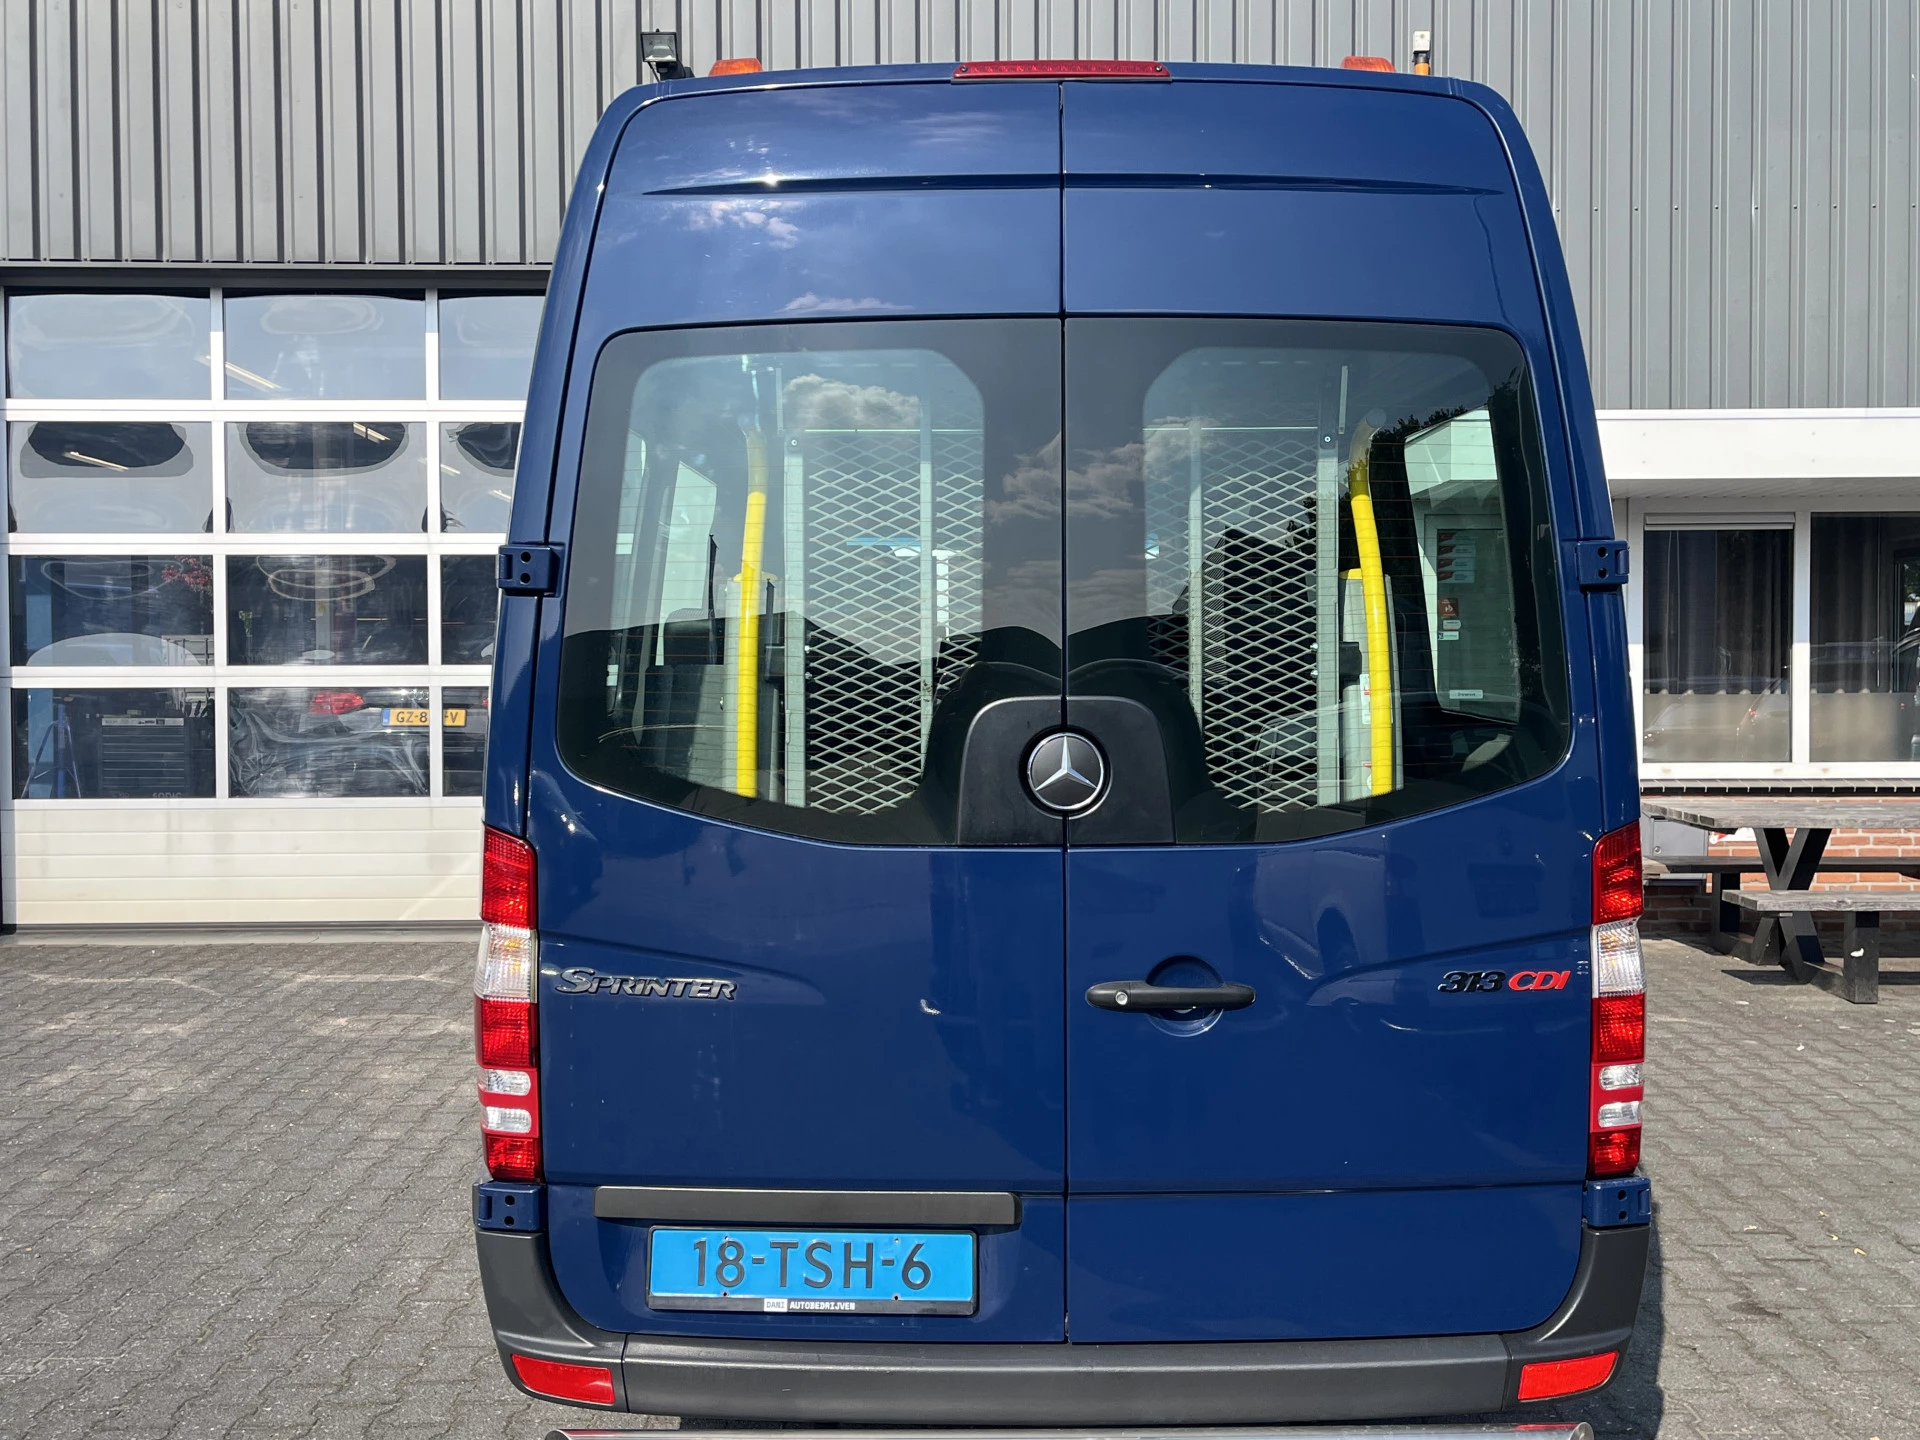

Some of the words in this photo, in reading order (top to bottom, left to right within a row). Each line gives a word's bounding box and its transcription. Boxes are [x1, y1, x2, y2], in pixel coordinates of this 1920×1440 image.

[396, 711, 459, 723] GZ-8-V
[555, 967, 737, 1000] SPRINTER
[1437, 970, 1506, 993] 313
[1508, 970, 1571, 992] CDI
[693, 1240, 931, 1290] 18-TSH-6
[790, 1301, 855, 1310] AUTOBEDRIJVEN
